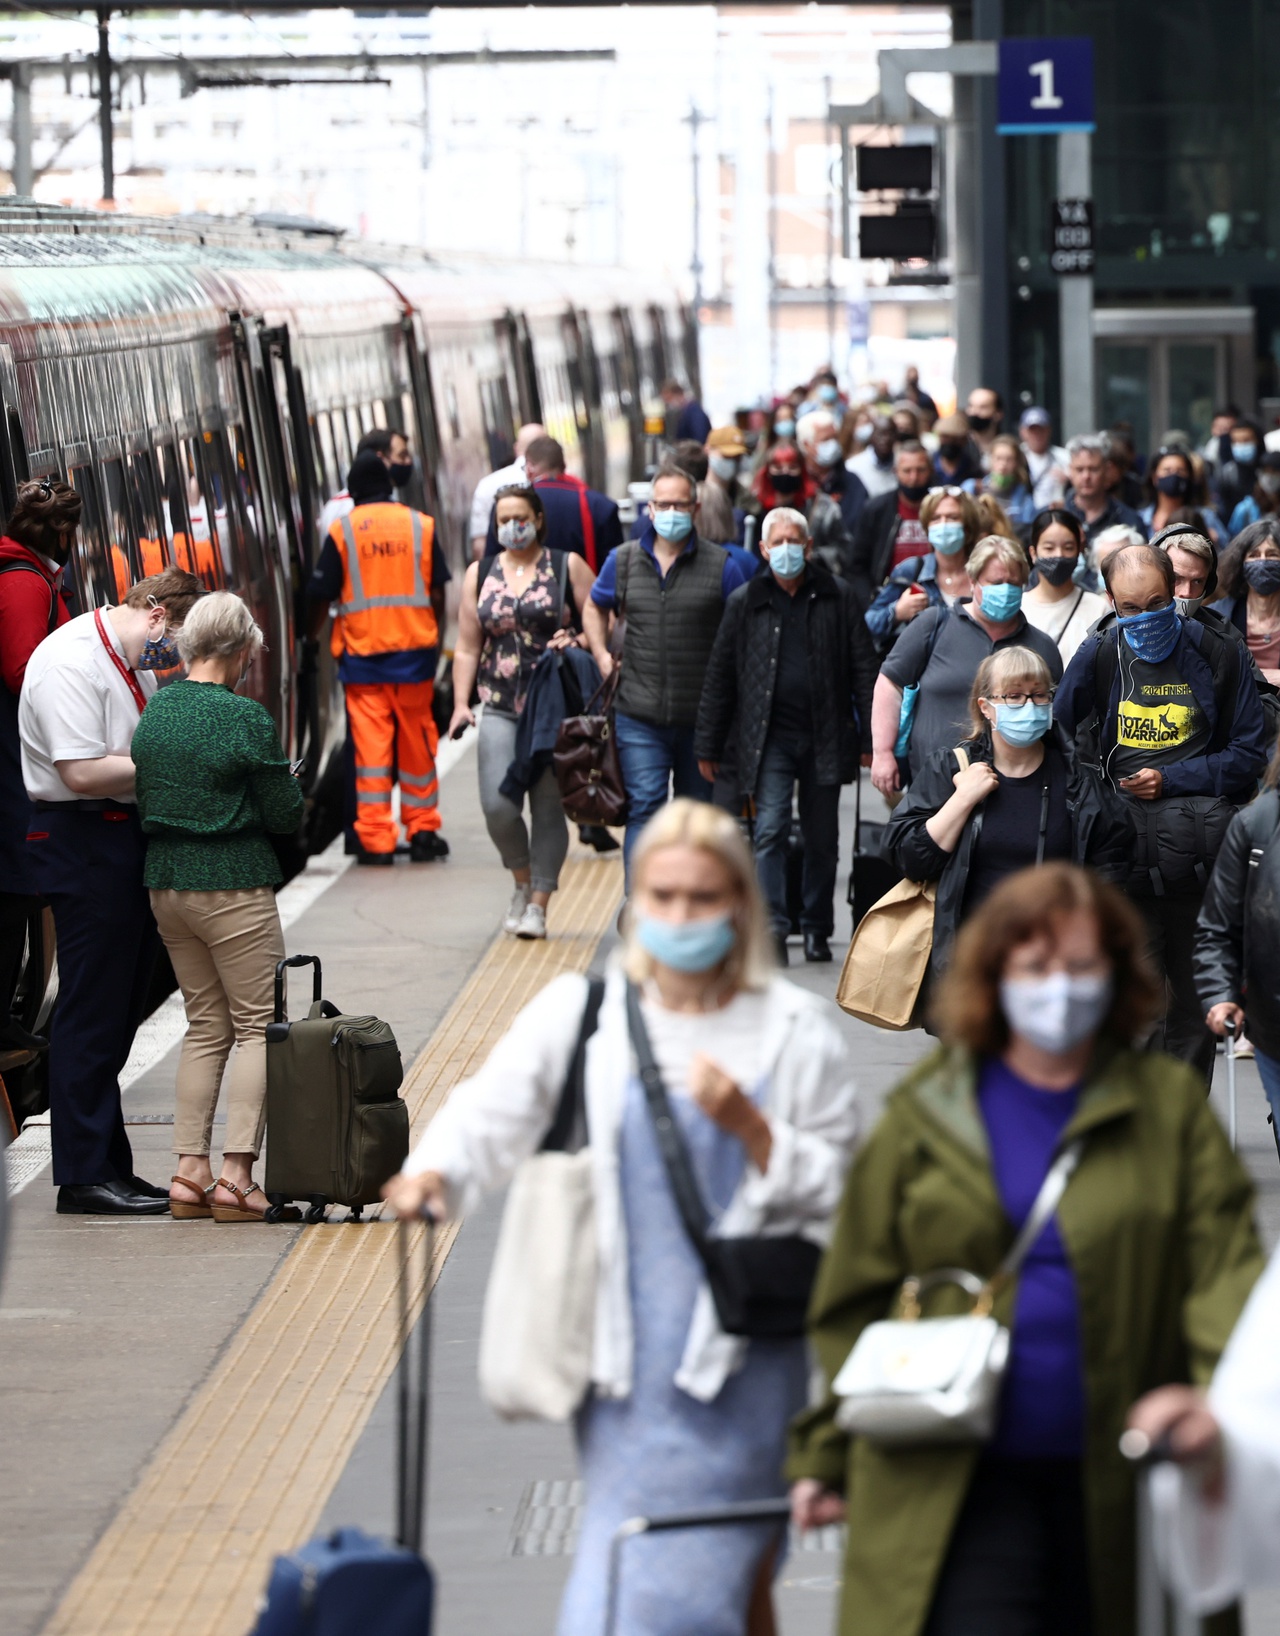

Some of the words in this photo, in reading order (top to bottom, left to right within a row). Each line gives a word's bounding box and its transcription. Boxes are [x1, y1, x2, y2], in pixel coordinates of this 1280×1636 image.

[1028, 59, 1063, 109] 1
[361, 542, 408, 559] LNER
[1145, 686, 1162, 695] 2021
[1118, 714, 1158, 731] TOTAL
[1121, 727, 1179, 742] WARRIOR
